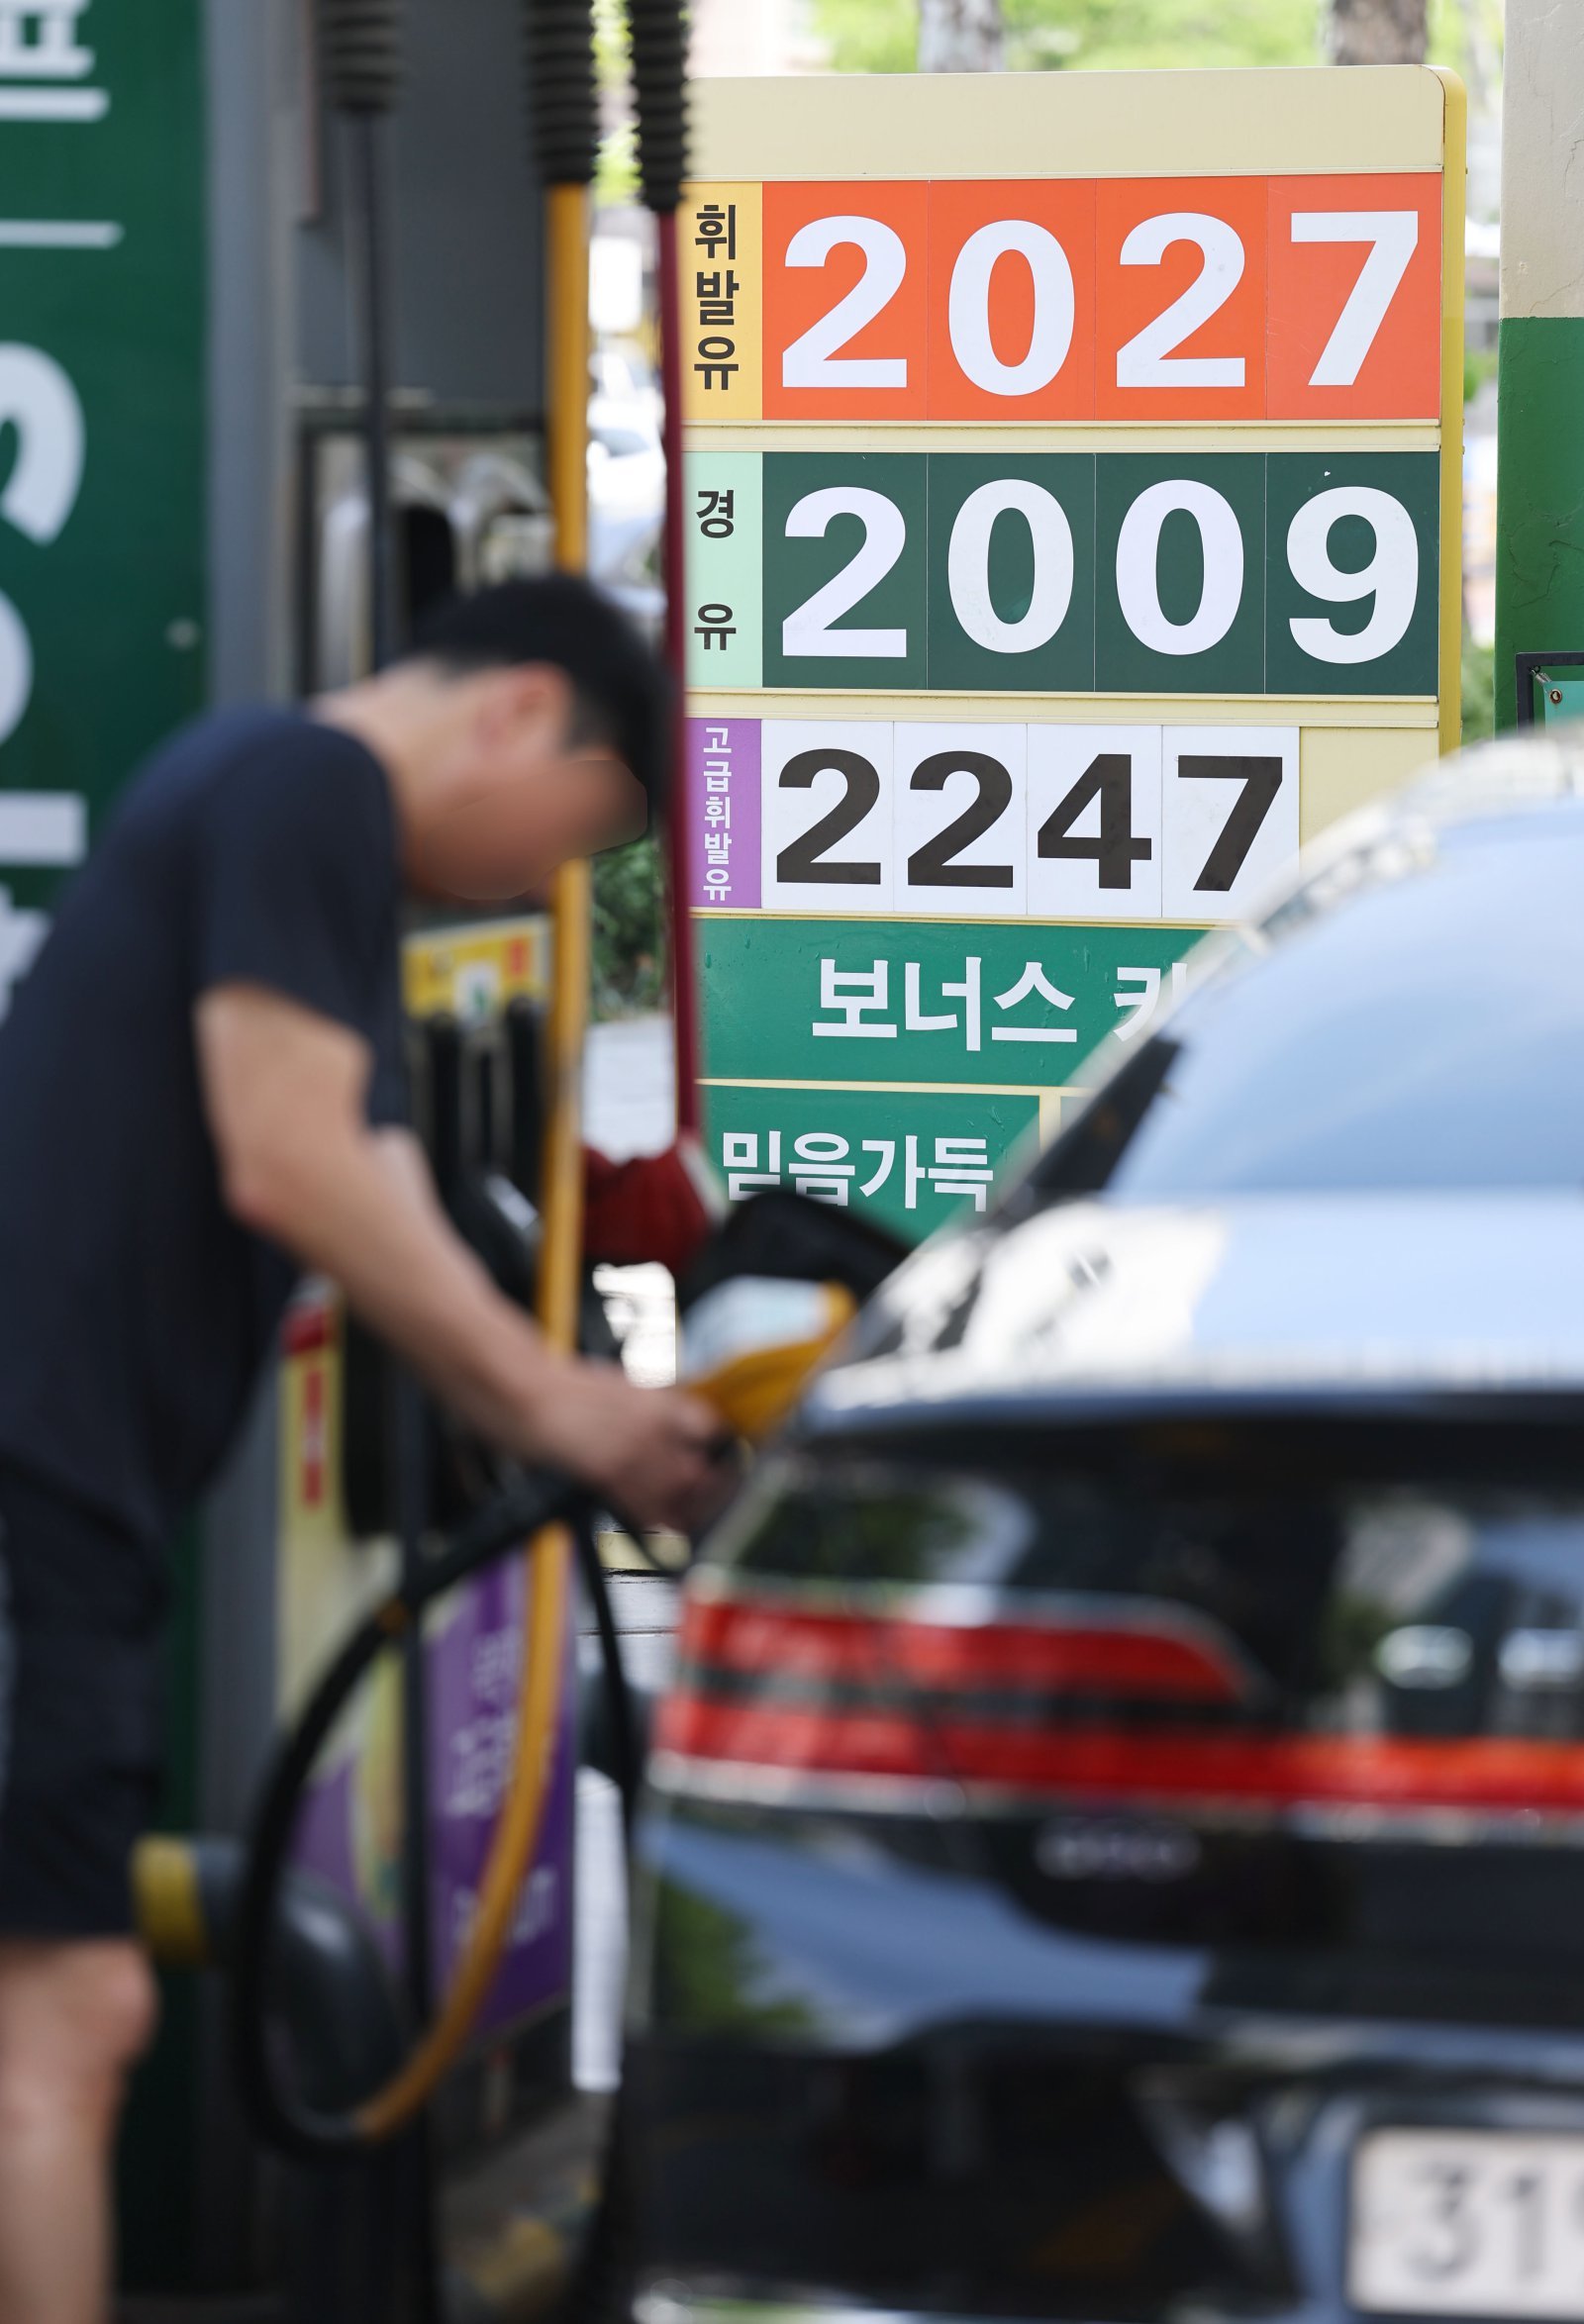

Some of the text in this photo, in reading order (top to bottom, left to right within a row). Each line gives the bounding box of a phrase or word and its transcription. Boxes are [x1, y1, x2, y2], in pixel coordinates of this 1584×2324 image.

[694, 204, 740, 391] 휘발유
[782, 211, 1420, 396] 2027
[782, 478, 1420, 664] 2009
[703, 727, 733, 902] 고급휘발유
[776, 748, 1283, 892] 2247
[812, 956, 1077, 1051] 보너스
[723, 1130, 994, 1212] 믿음가득
[1401, 2161, 1584, 2286] 31
